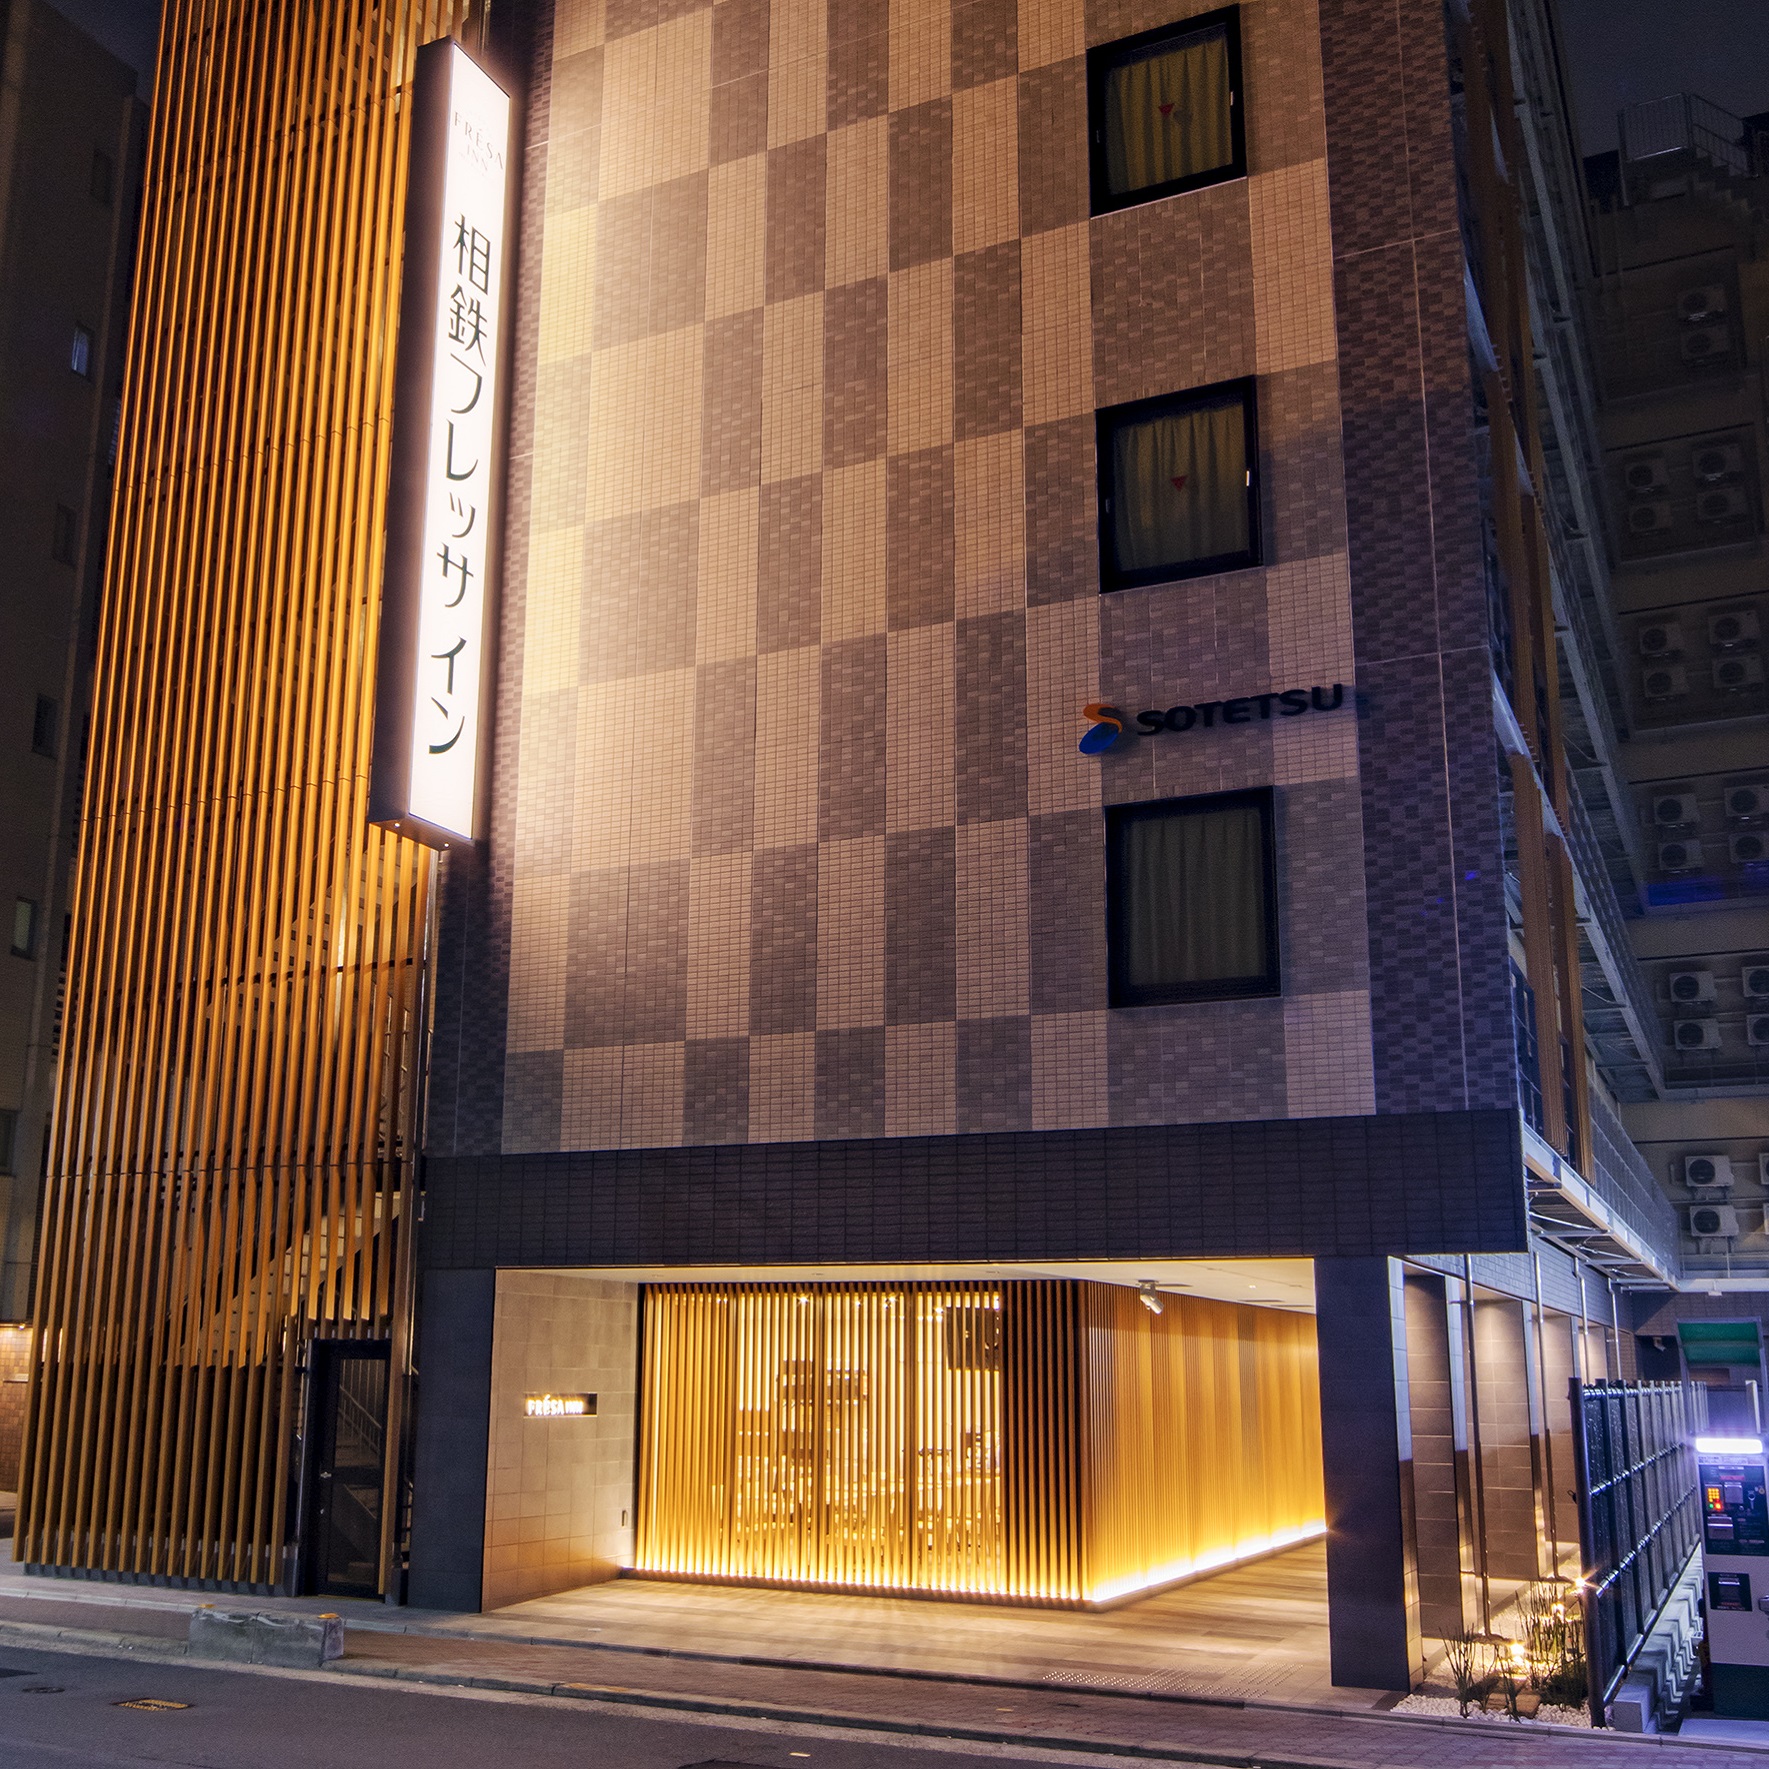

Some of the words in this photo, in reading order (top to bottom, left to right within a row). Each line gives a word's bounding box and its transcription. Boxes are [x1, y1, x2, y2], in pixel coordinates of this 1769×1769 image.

[428, 213, 491, 755] 相鉄フレッサイン
[1136, 683, 1343, 736] SOTETSU
